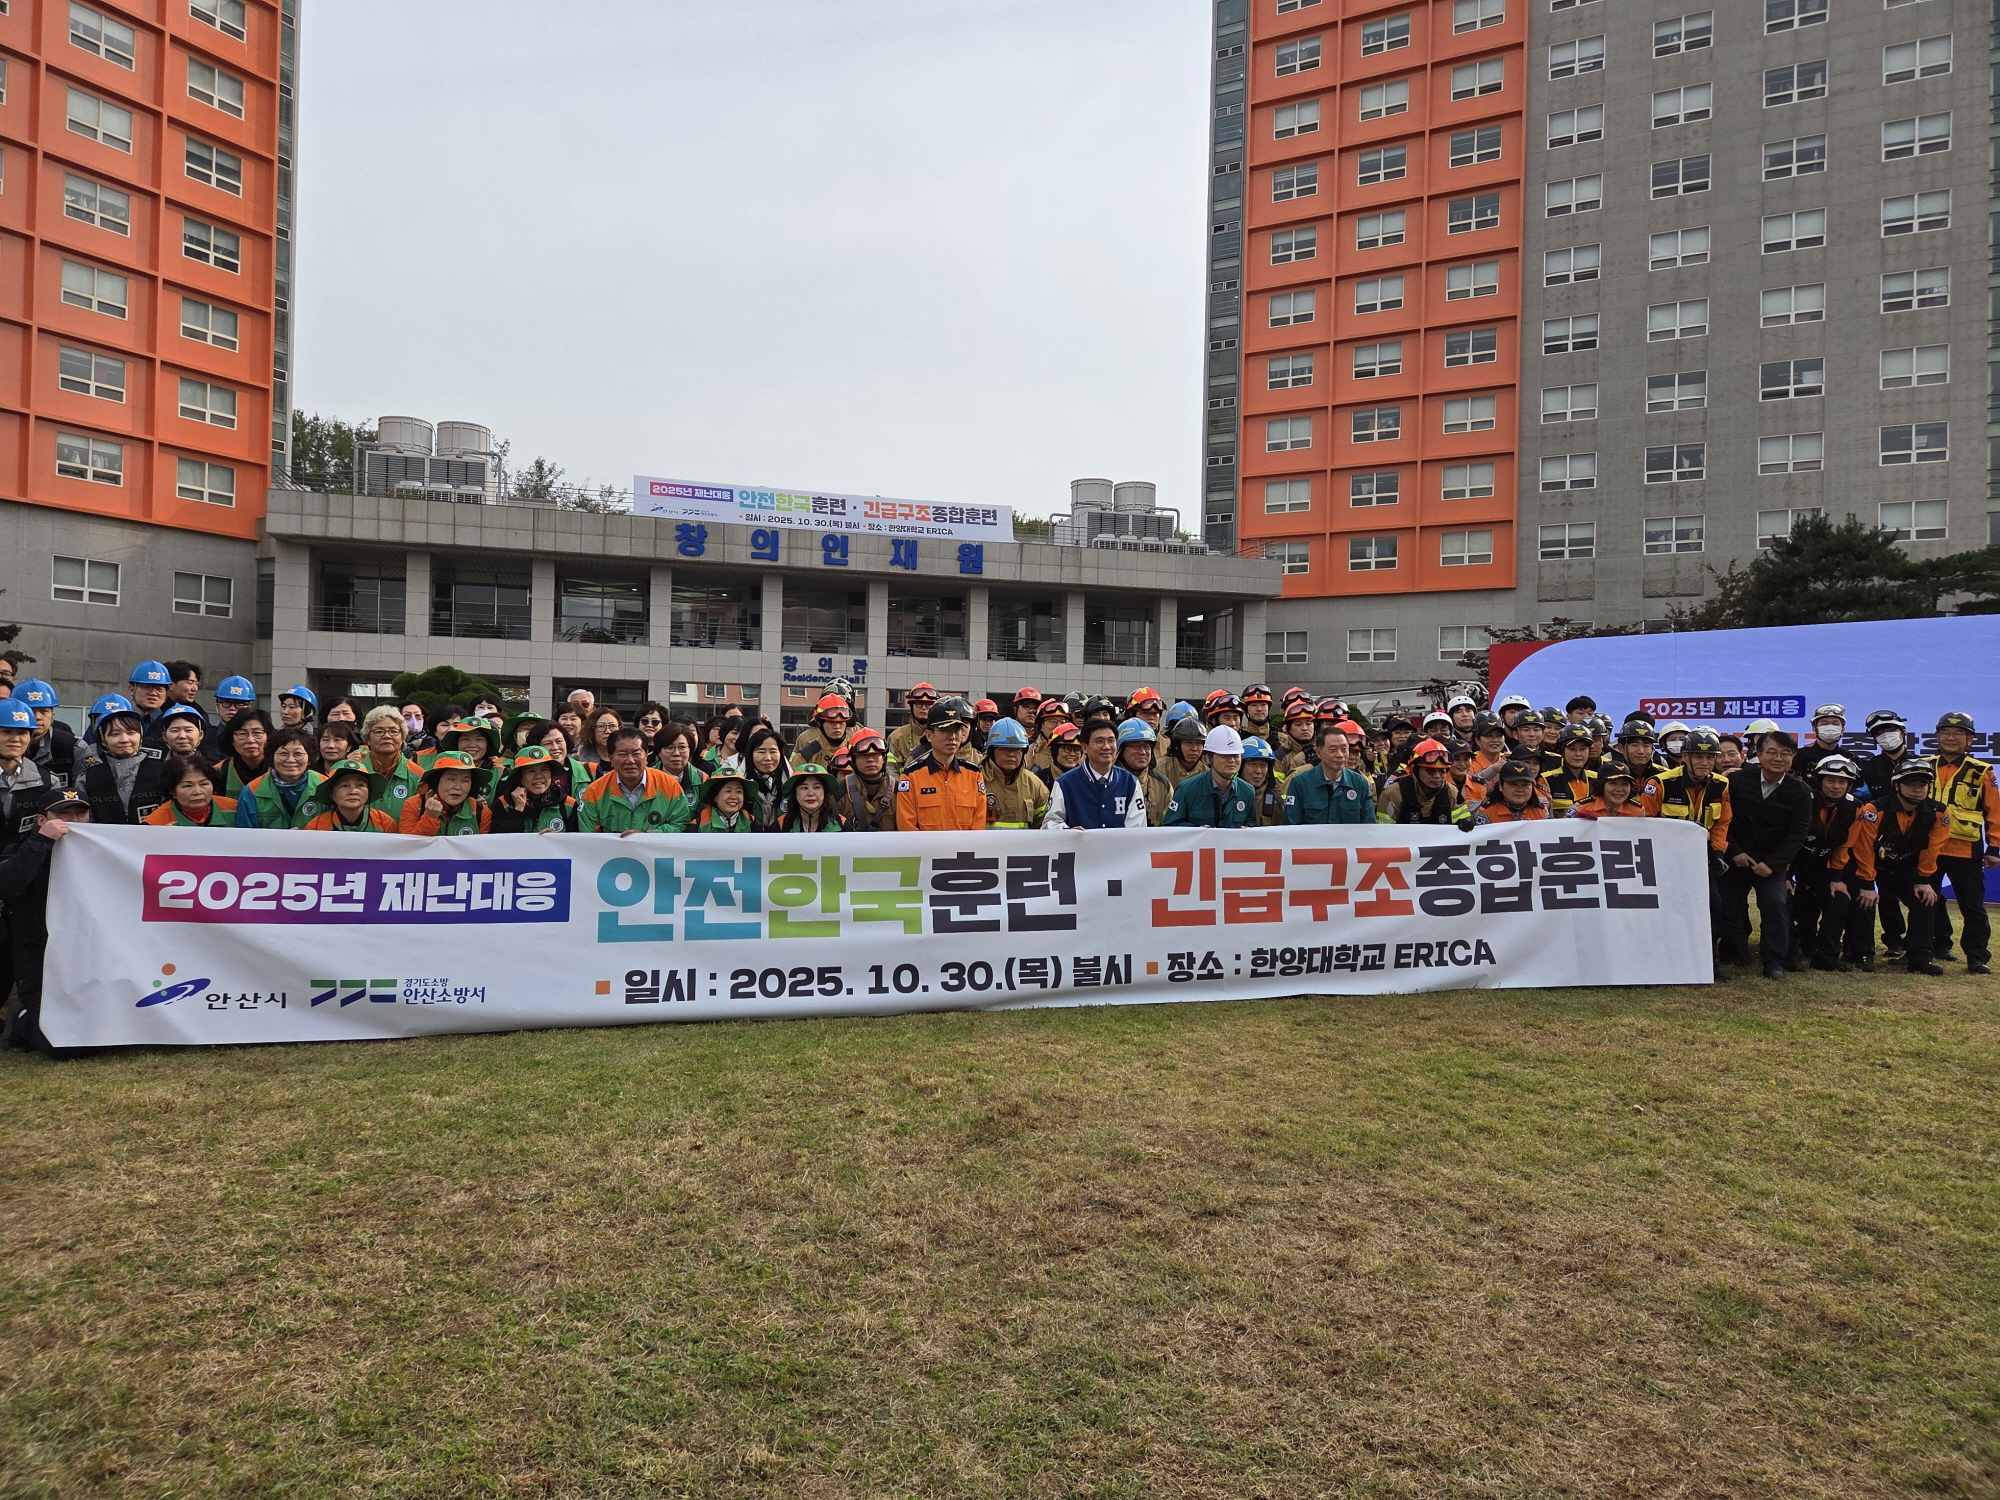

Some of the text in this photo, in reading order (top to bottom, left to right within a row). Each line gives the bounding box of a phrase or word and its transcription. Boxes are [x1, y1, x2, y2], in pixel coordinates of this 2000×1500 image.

[653, 485, 693, 497] 2025년
[694, 488, 731, 500] 재난대응
[738, 489, 846, 516] 안전한국훈련
[863, 500, 998, 526] 긴급구조종합훈련
[745, 513, 761, 522] 일시
[767, 516, 795, 525] 2025.
[798, 517, 813, 526] 10.
[867, 523, 883, 532] 장소
[888, 524, 925, 534] 한양대학교
[926, 528, 954, 536] ERICA
[675, 523, 984, 575] 창의인재원
[782, 655, 868, 675] 창의관
[1644, 699, 1800, 717] 2025년 재난대응
[1114, 796, 1127, 815] H
[157, 870, 366, 913] 2025년
[379, 871, 557, 913] 재난대응
[597, 851, 1078, 943] 안전한국훈련
[1150, 836, 1661, 928] 긴급구조종합훈련
[624, 968, 697, 1005] 일시
[729, 966, 854, 1001] 2025.
[867, 963, 929, 994] 10.
[940, 954, 1062, 992] 30.(목)
[1072, 953, 1133, 988] 불시
[1166, 950, 1225, 984] 장소
[1249, 943, 1387, 979] 한양대학교
[1393, 938, 1497, 970] ERICA
[404, 978, 449, 988] 경기도소방
[205, 990, 287, 1010] 안산시
[403, 986, 486, 1005] 안산소방서
